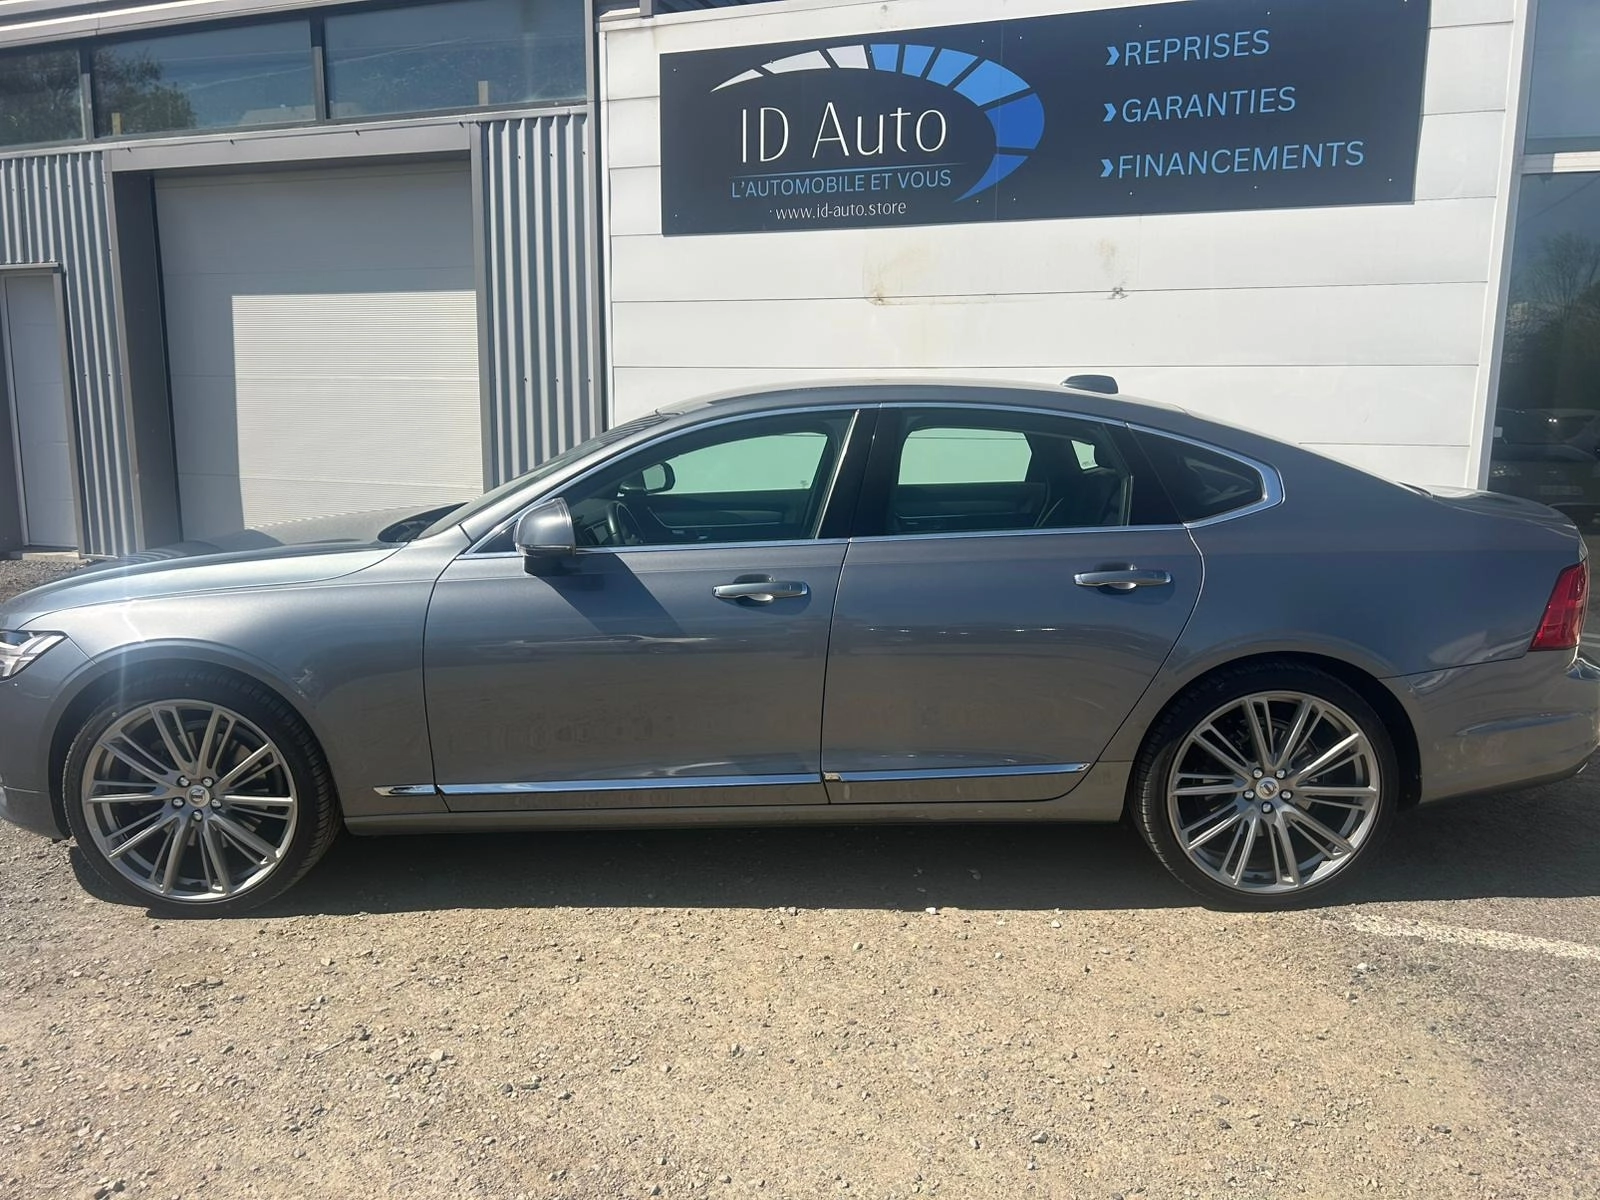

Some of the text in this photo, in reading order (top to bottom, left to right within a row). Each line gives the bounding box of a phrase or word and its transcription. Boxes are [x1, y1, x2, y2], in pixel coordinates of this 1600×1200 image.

[1124, 29, 1270, 66] REPRISES
[1122, 86, 1296, 123] GARANTIES
[742, 101, 947, 163] ID Auto
[1118, 140, 1364, 179] FINANCEMENTS
[871, 173, 893, 191] ET
[897, 169, 951, 189] VOUS
[775, 201, 907, 220] www.id-auto.store
